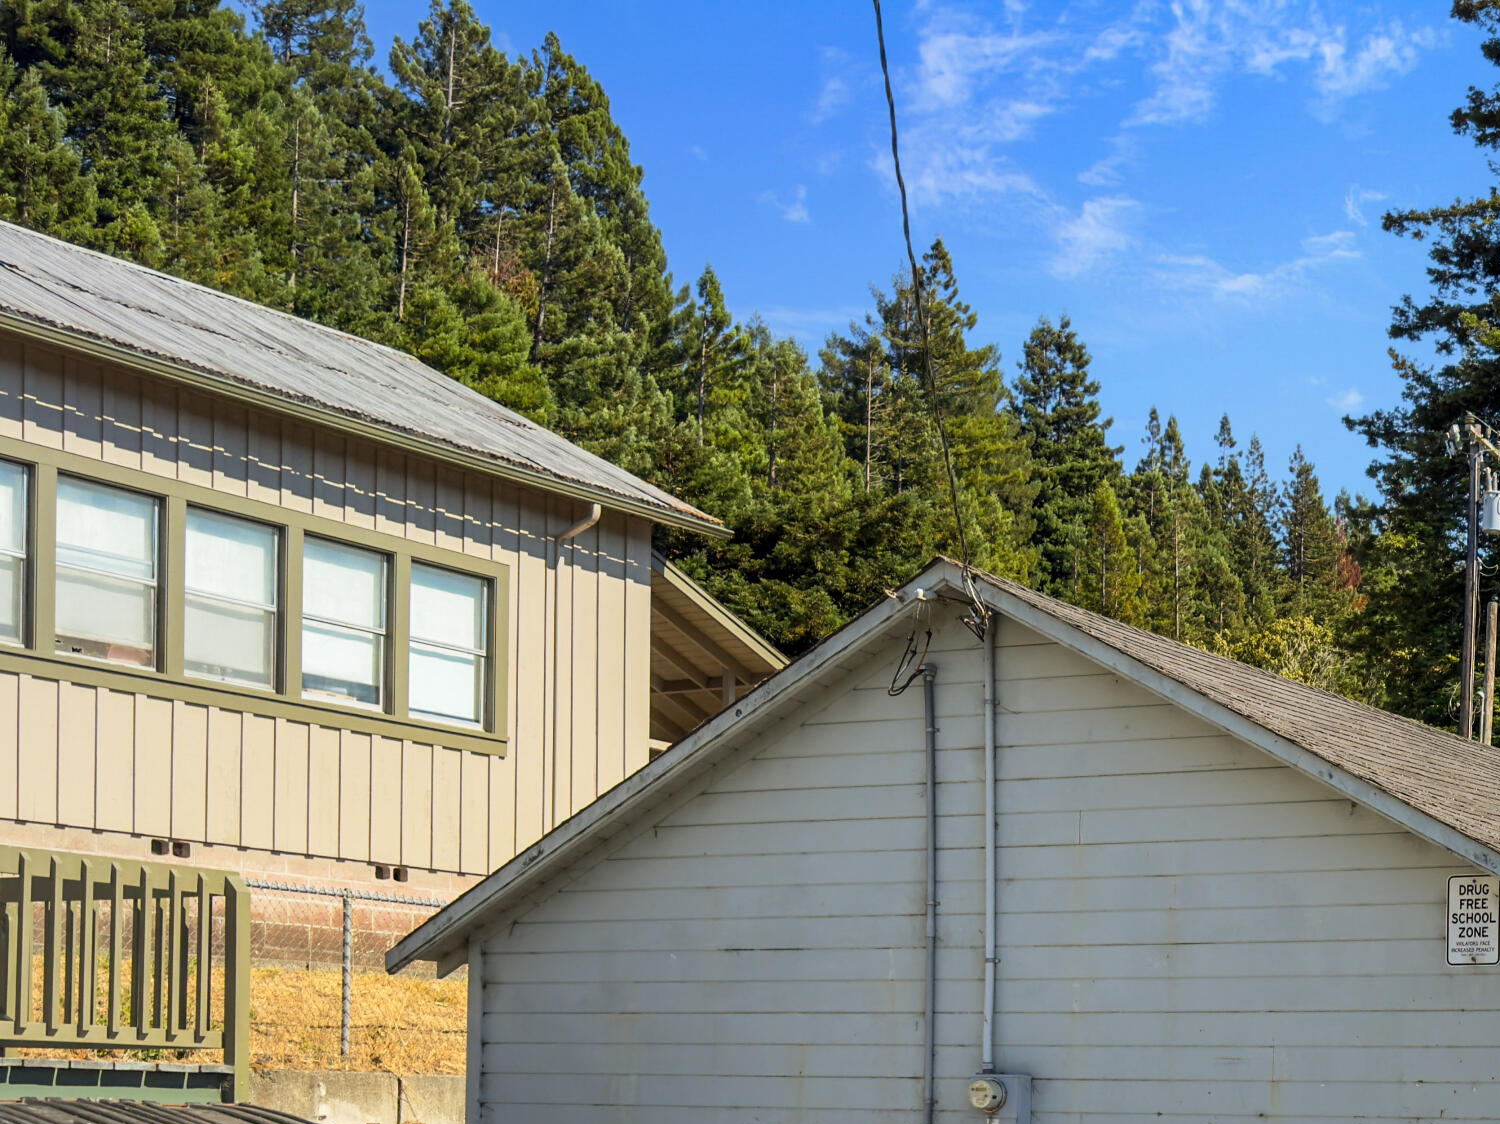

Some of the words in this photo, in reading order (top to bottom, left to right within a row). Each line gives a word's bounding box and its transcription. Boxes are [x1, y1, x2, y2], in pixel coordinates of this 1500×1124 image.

[1459, 884, 1489, 895] DRUG
[1459, 898, 1488, 910] FREE
[1451, 912, 1496, 924] SCHOOL
[1458, 926, 1489, 938] ZONE
